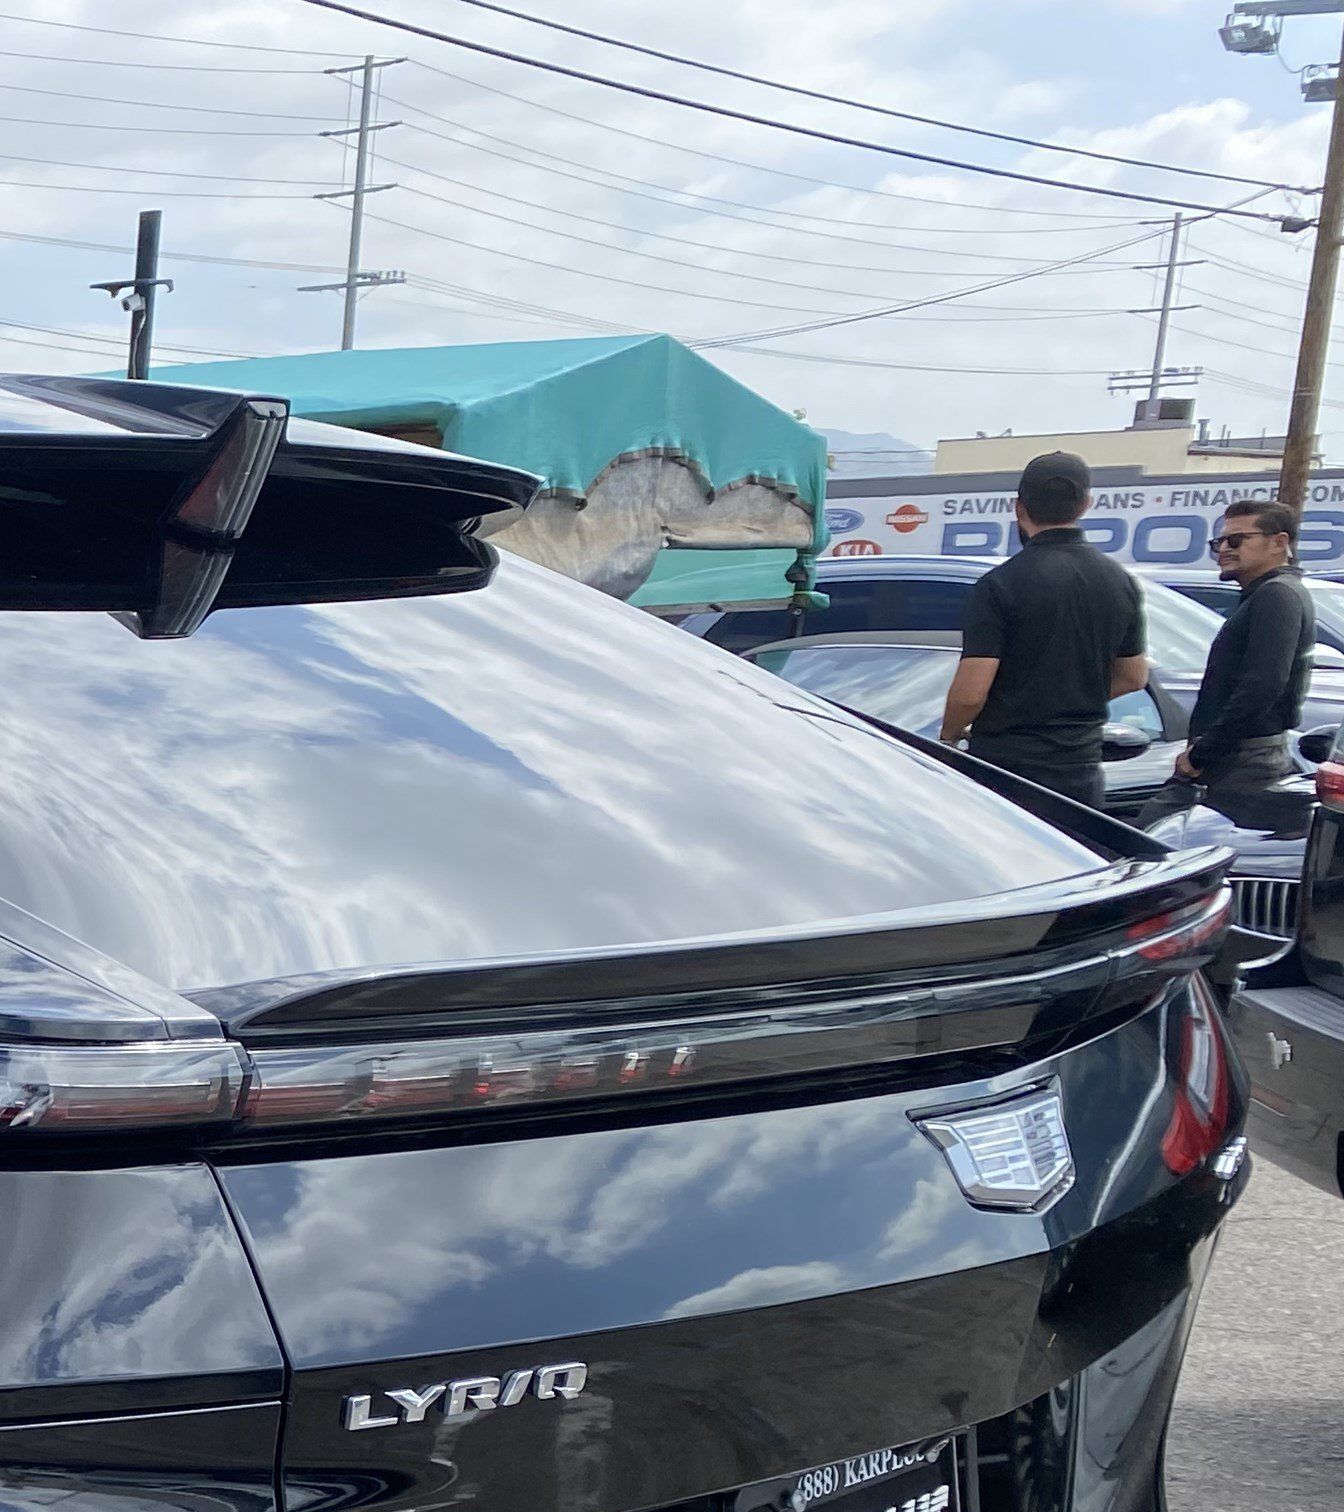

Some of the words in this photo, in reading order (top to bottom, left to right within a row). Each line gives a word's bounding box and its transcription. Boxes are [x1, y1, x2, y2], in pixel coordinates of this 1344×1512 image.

[943, 497, 1017, 516] SAVIN
[1094, 491, 1146, 511] ANS
[1302, 484, 1344, 503] OM
[839, 543, 876, 556] KIA
[342, 1361, 588, 1431] LYRIQ
[797, 1464, 840, 1502] (888)
